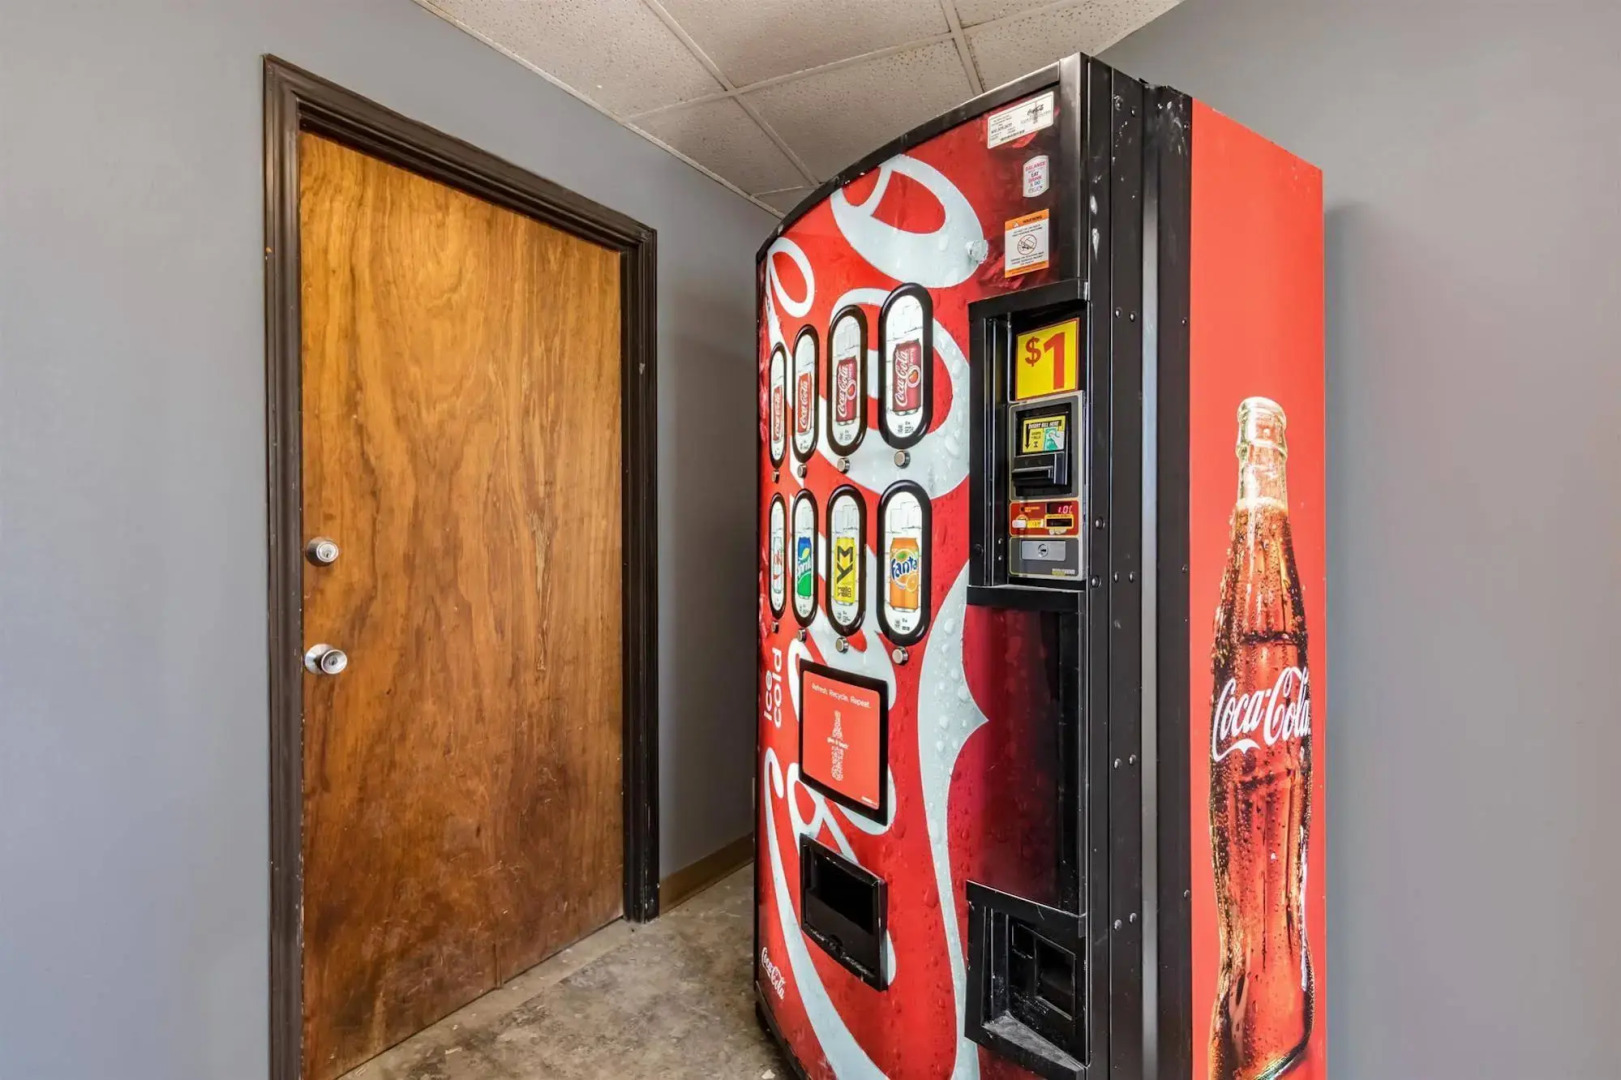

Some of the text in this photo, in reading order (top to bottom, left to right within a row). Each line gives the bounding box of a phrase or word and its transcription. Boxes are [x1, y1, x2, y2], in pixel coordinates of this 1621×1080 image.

[895, 348, 908, 407] Coca-Cola
[1025, 332, 1065, 389] $1
[773, 648, 782, 728] cold
[1212, 666, 1311, 762] Coca-Cola
